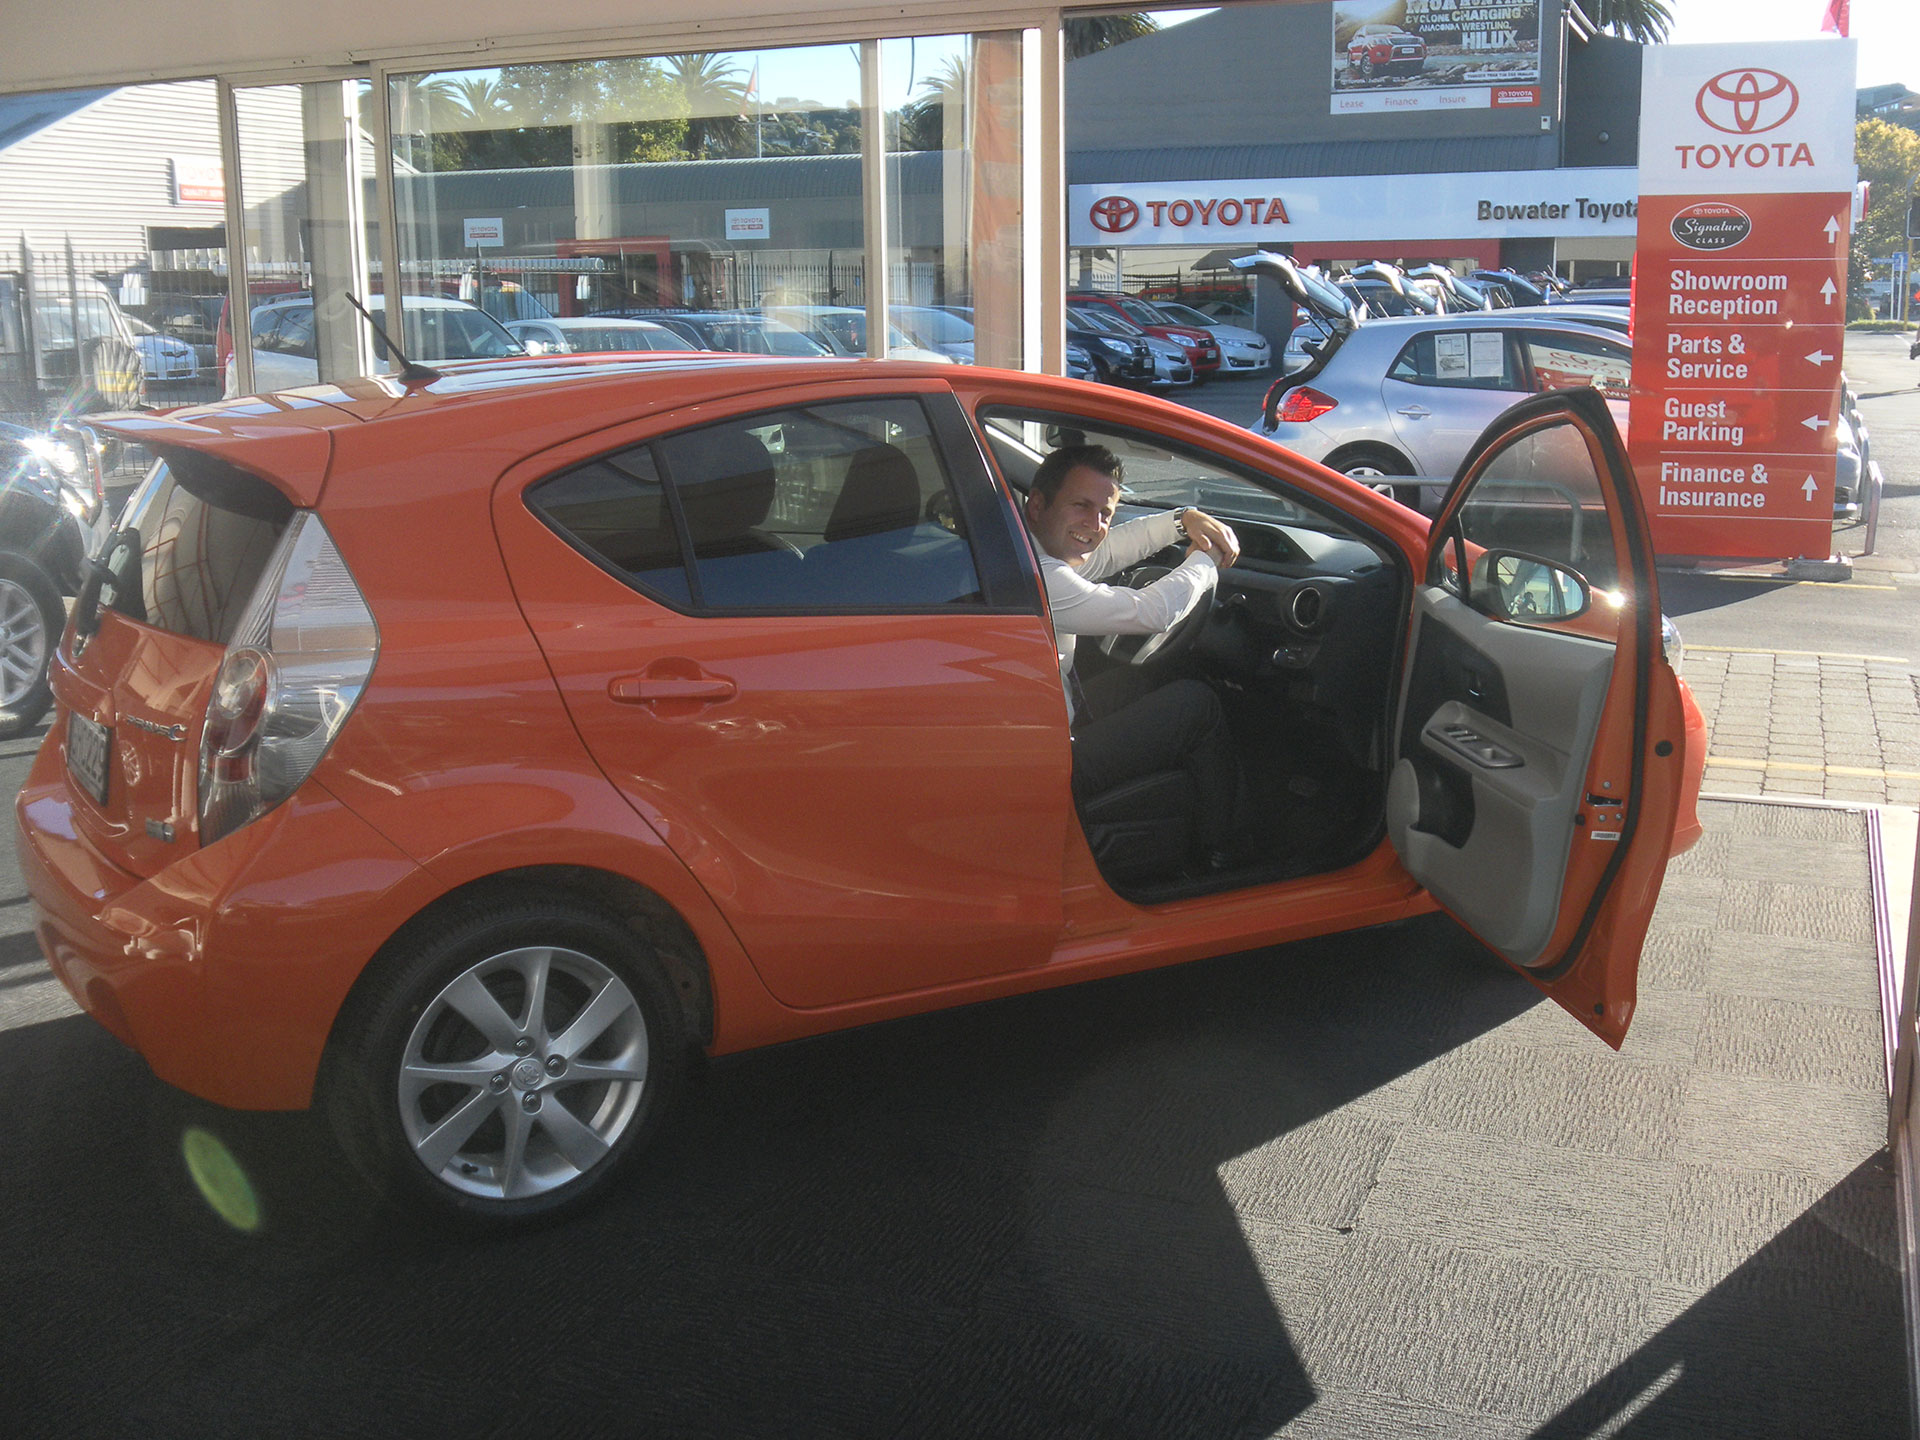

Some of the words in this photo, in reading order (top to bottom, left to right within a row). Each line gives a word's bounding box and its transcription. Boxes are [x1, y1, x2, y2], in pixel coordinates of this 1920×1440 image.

[1405, 13, 1450, 24] CYCLONE
[1461, 30, 1518, 50] HILUX
[1340, 100, 1364, 109] Lease
[1385, 97, 1419, 106] Finance
[1439, 95, 1466, 104] Insure
[1674, 142, 1815, 169] TOYOTA
[1146, 198, 1290, 227] TOYOTA
[1477, 200, 1570, 221] Bowater
[1679, 217, 1744, 236] Signature
[1670, 269, 1788, 291] Showroom
[1668, 294, 1778, 320] Reception
[1667, 333, 1722, 354] Parts
[1728, 333, 1746, 354] &
[1666, 358, 1748, 379] Service
[1664, 397, 1727, 419] Guest
[1663, 421, 1744, 446] Parking
[1660, 462, 1745, 483] Finance
[1751, 463, 1769, 484] &
[1659, 486, 1766, 508] Insurance
